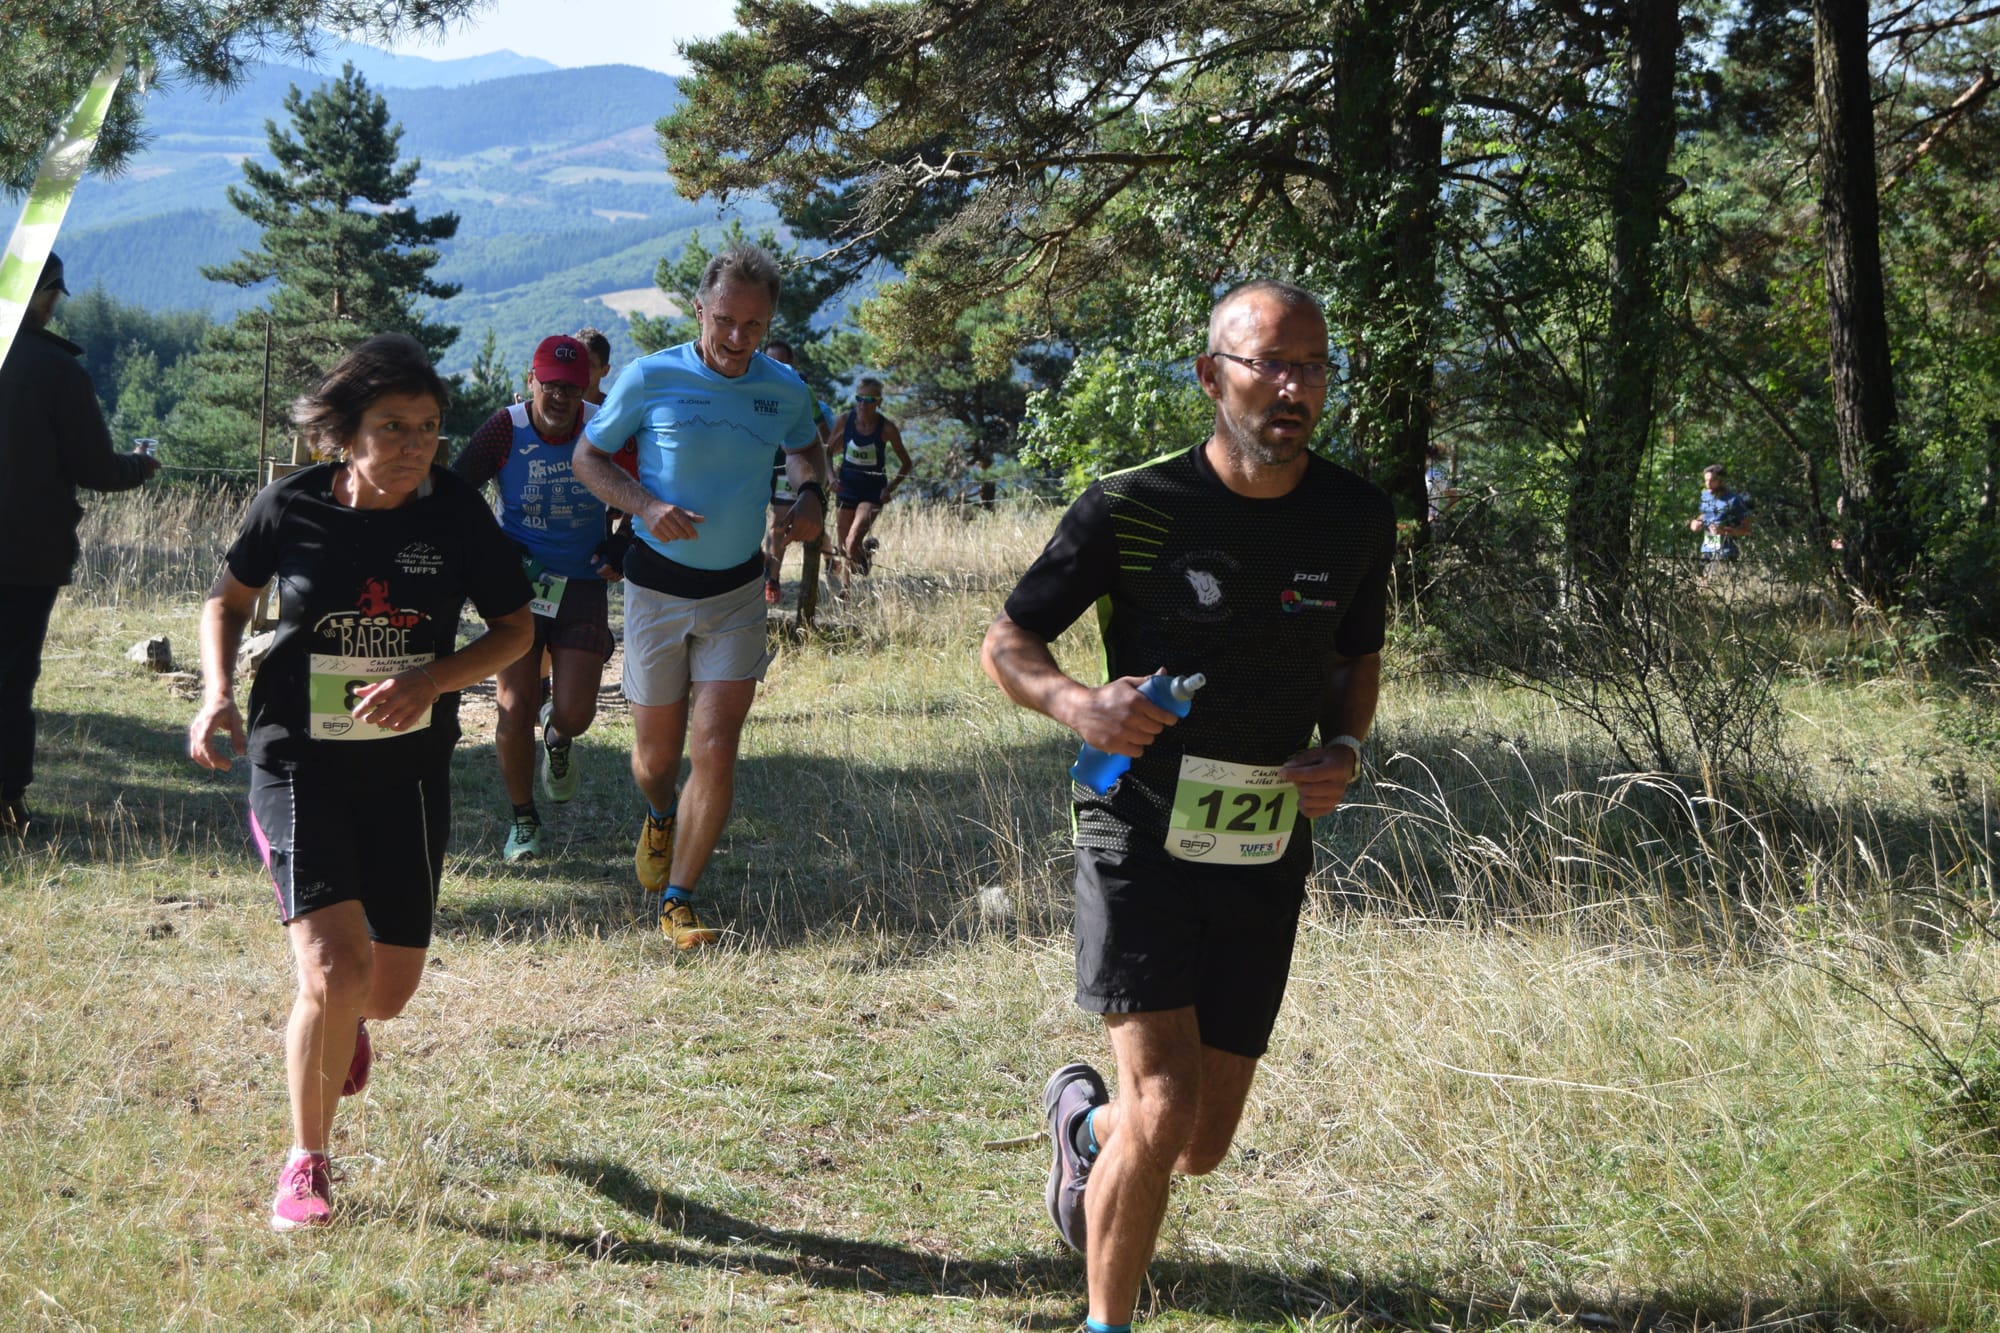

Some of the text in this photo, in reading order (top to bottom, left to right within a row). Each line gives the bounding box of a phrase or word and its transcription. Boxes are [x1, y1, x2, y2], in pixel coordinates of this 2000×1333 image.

[1293, 572, 1329, 583] poli
[330, 617, 355, 628] LE
[341, 624, 411, 657] BARRE
[370, 657, 409, 666] Challenge
[322, 721, 349, 730] BFP
[1197, 789, 1285, 831] 121
[1180, 839, 1211, 850] BFP
[1240, 842, 1274, 852] TUFF'S
